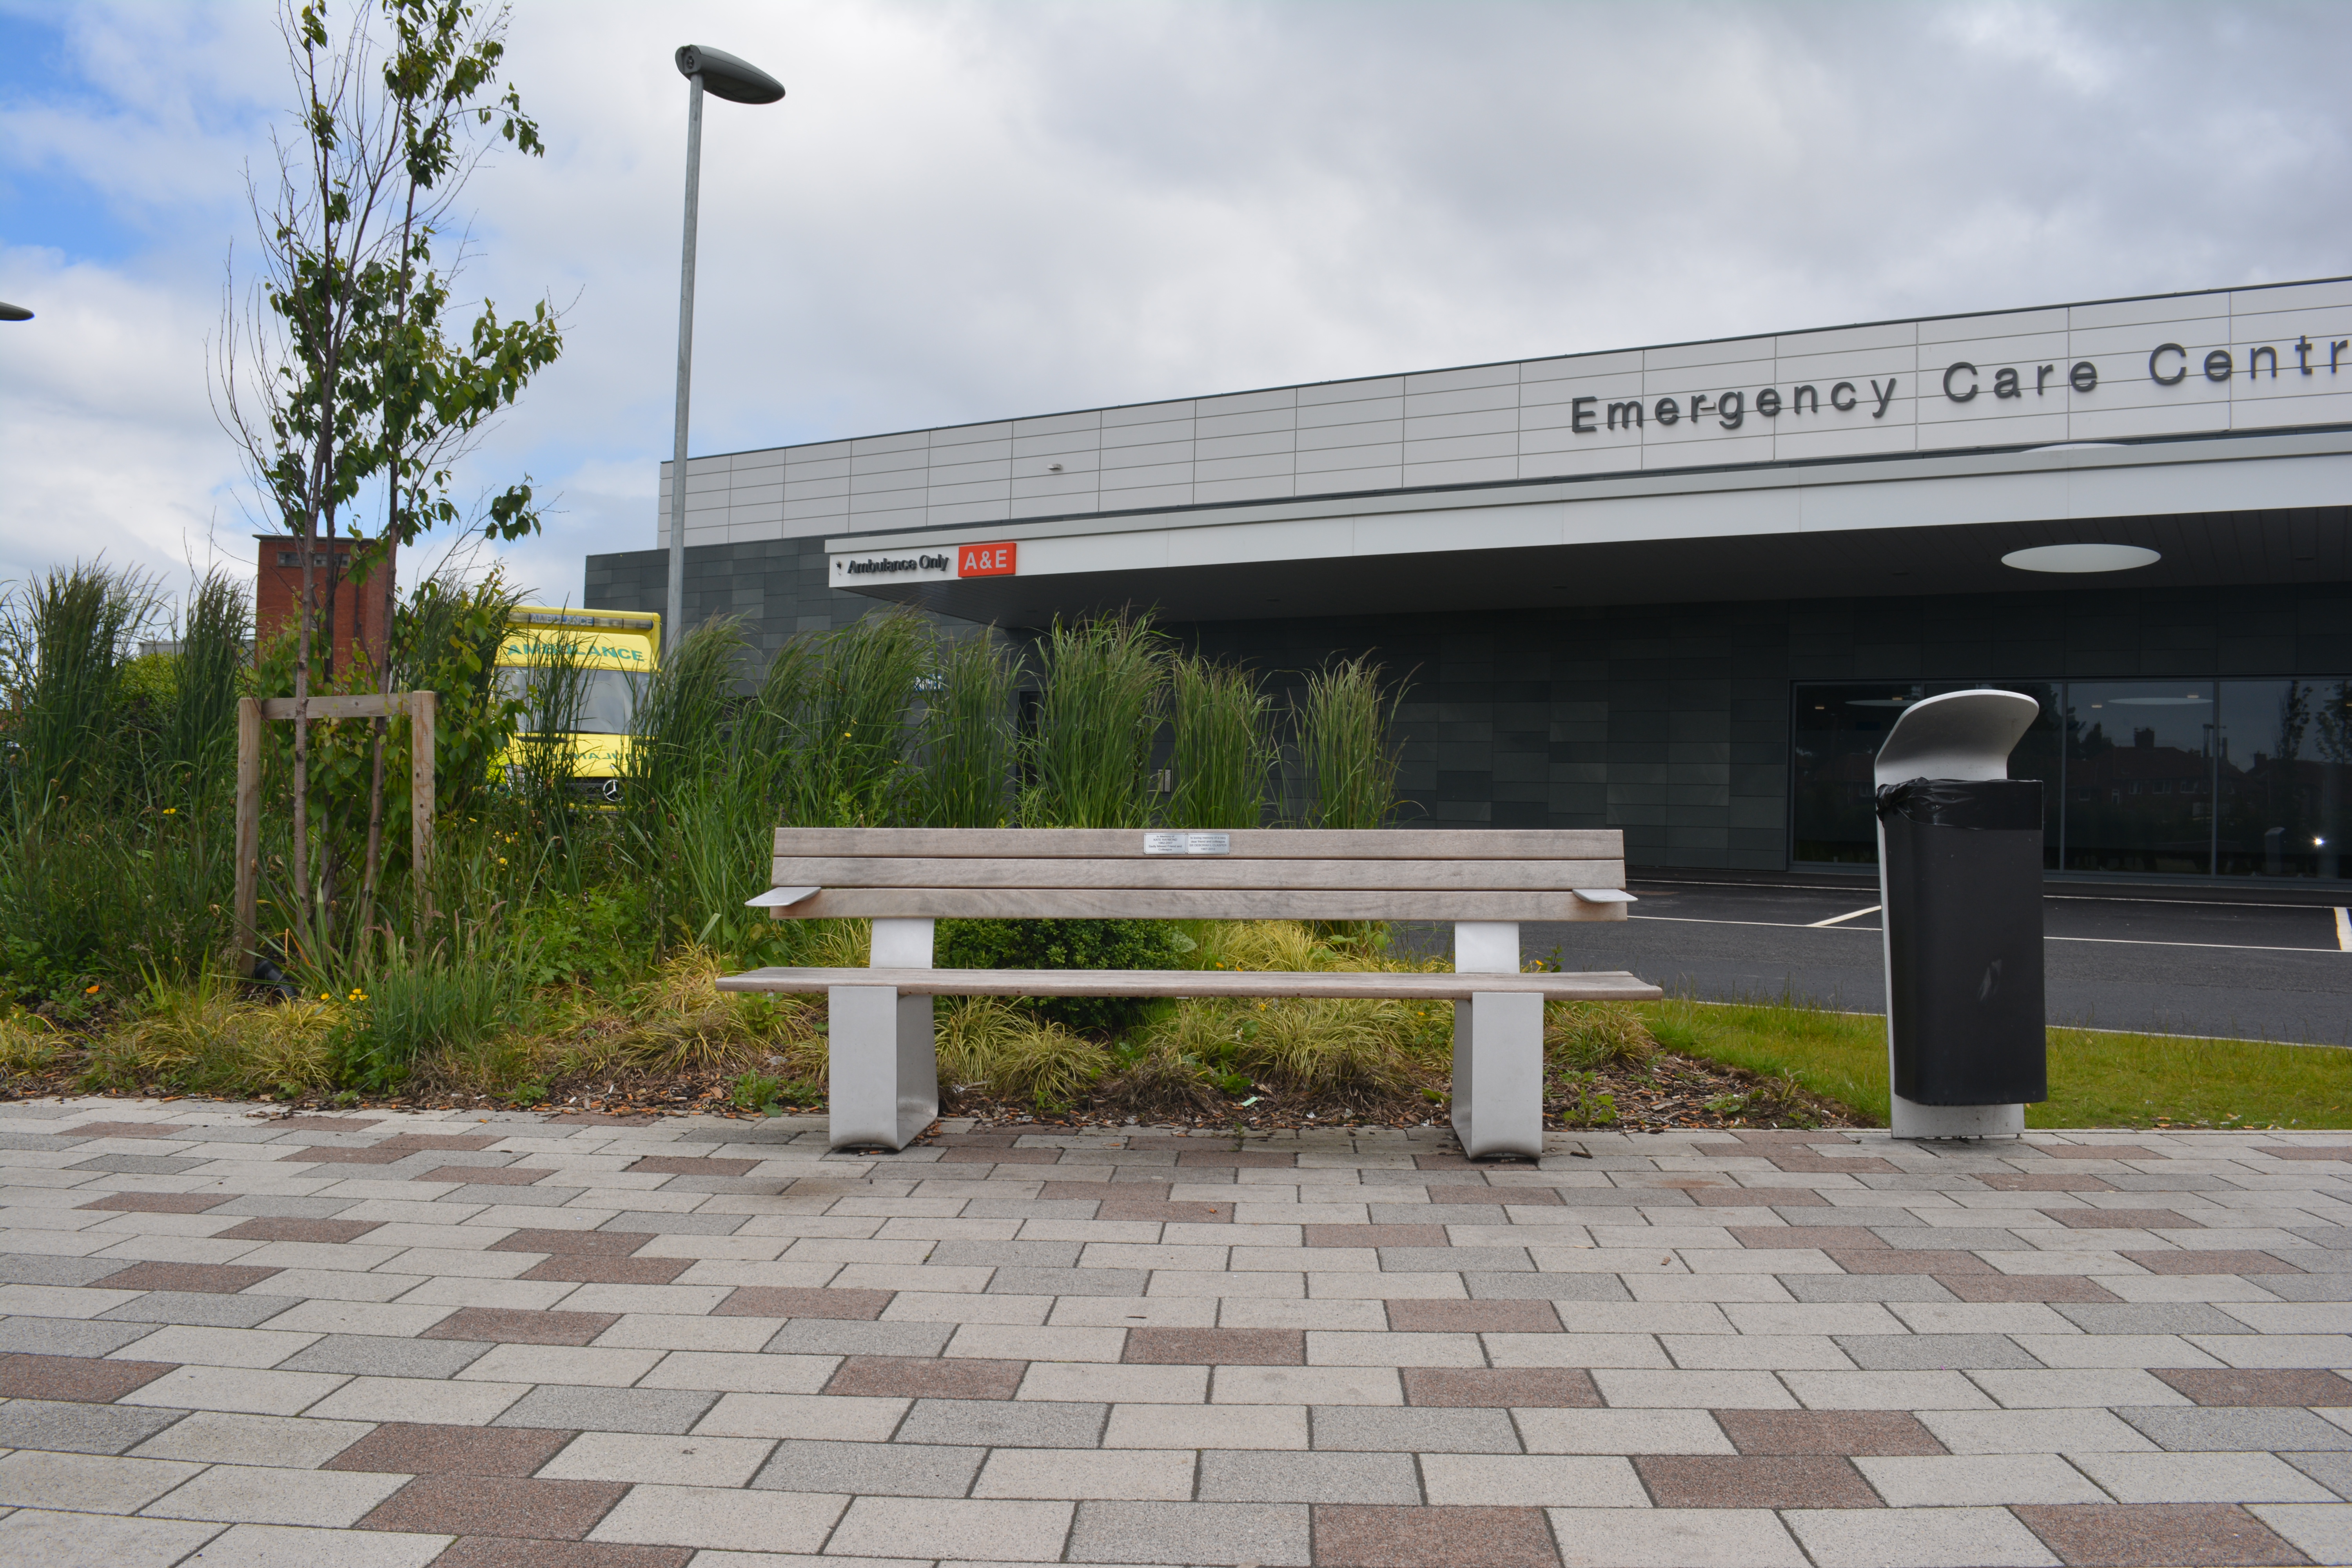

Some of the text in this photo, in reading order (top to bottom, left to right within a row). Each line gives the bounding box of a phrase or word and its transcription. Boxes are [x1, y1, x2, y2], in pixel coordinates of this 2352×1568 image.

[1572, 378, 1896, 433] Emergency
[1943, 361, 2097, 403] Care
[848, 554, 949, 573] Ambulance Only
[964, 550, 1007, 570] A&E
[532, 613, 593, 626] AMBULANCE
